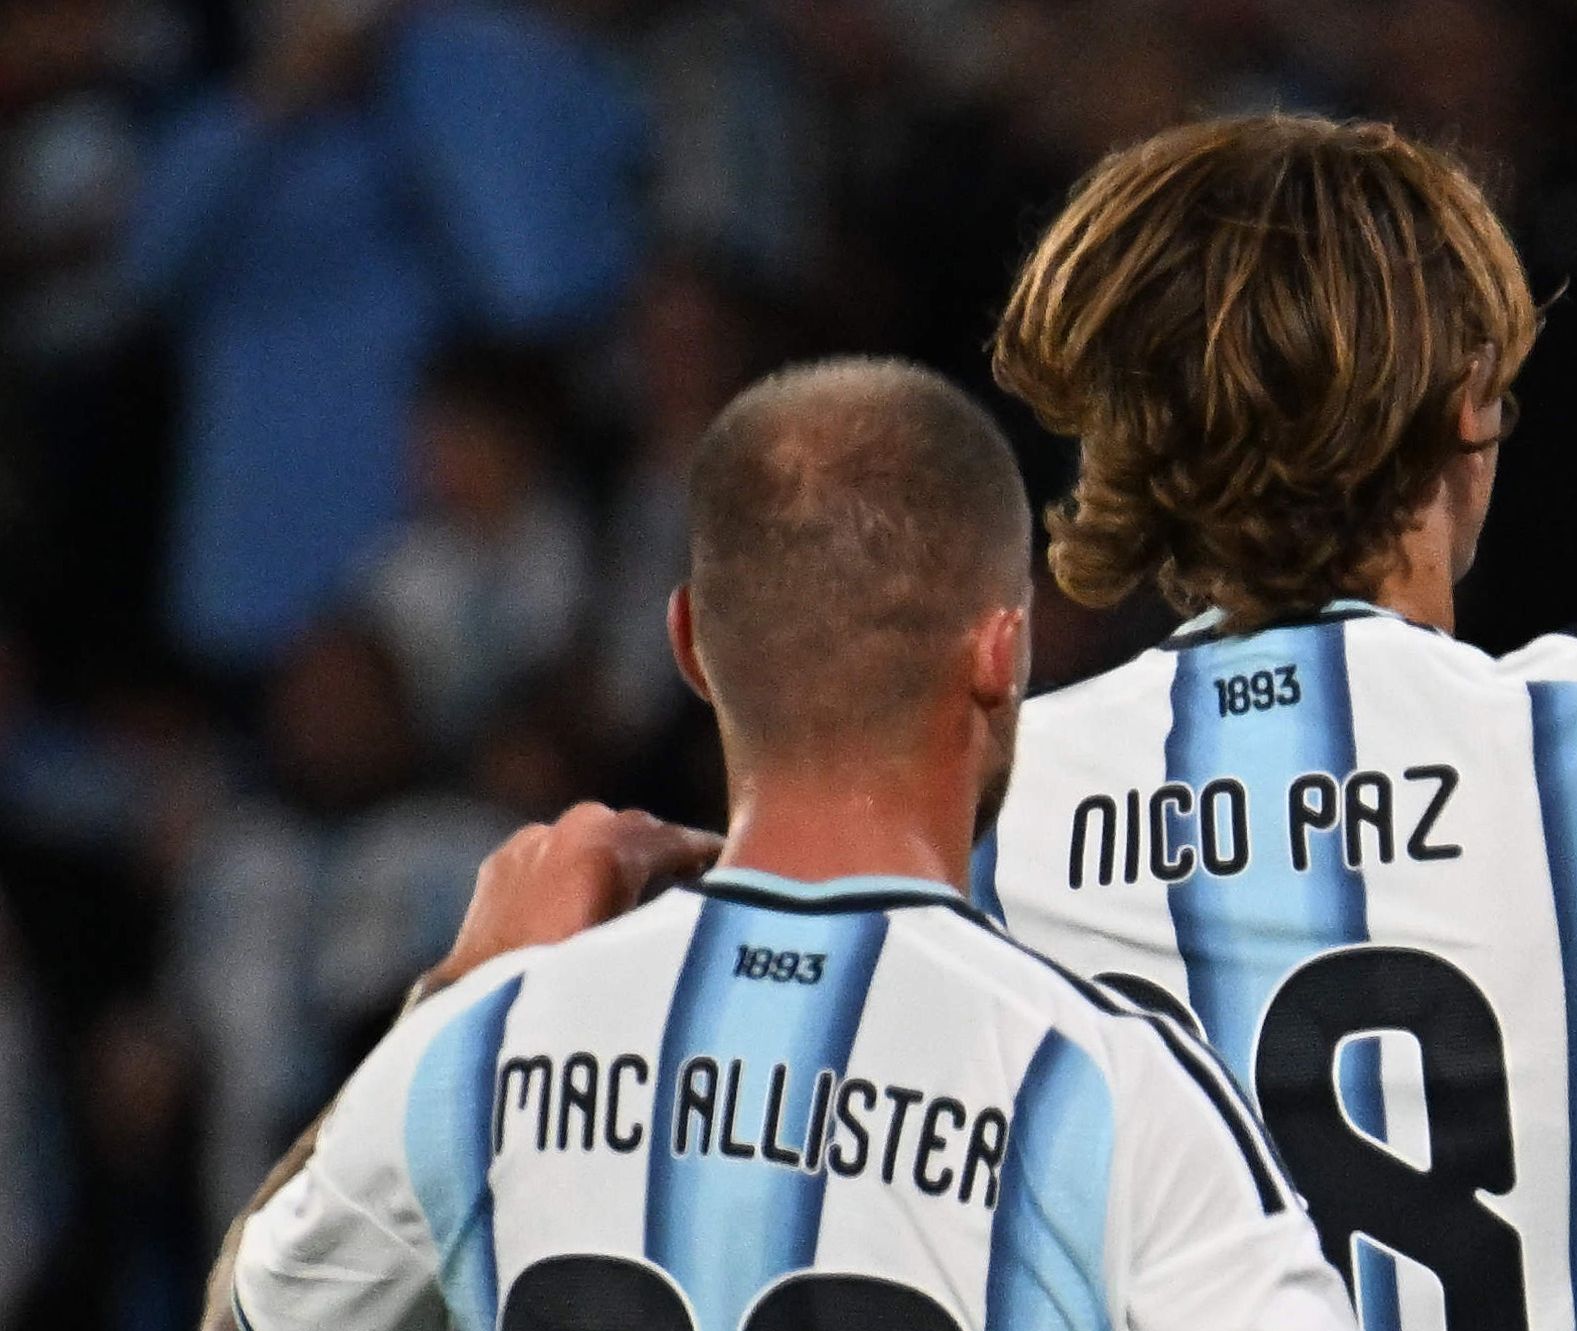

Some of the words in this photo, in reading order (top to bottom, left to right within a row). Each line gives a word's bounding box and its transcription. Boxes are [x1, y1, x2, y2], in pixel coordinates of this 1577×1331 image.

[1213, 663, 1301, 718] 1893
[1068, 777, 1249, 890] NICO
[1287, 763, 1463, 873] PAZ
[734, 944, 827, 985] 1893
[494, 1050, 649, 1157] MAC
[670, 1054, 1008, 1210] ALLISTER
